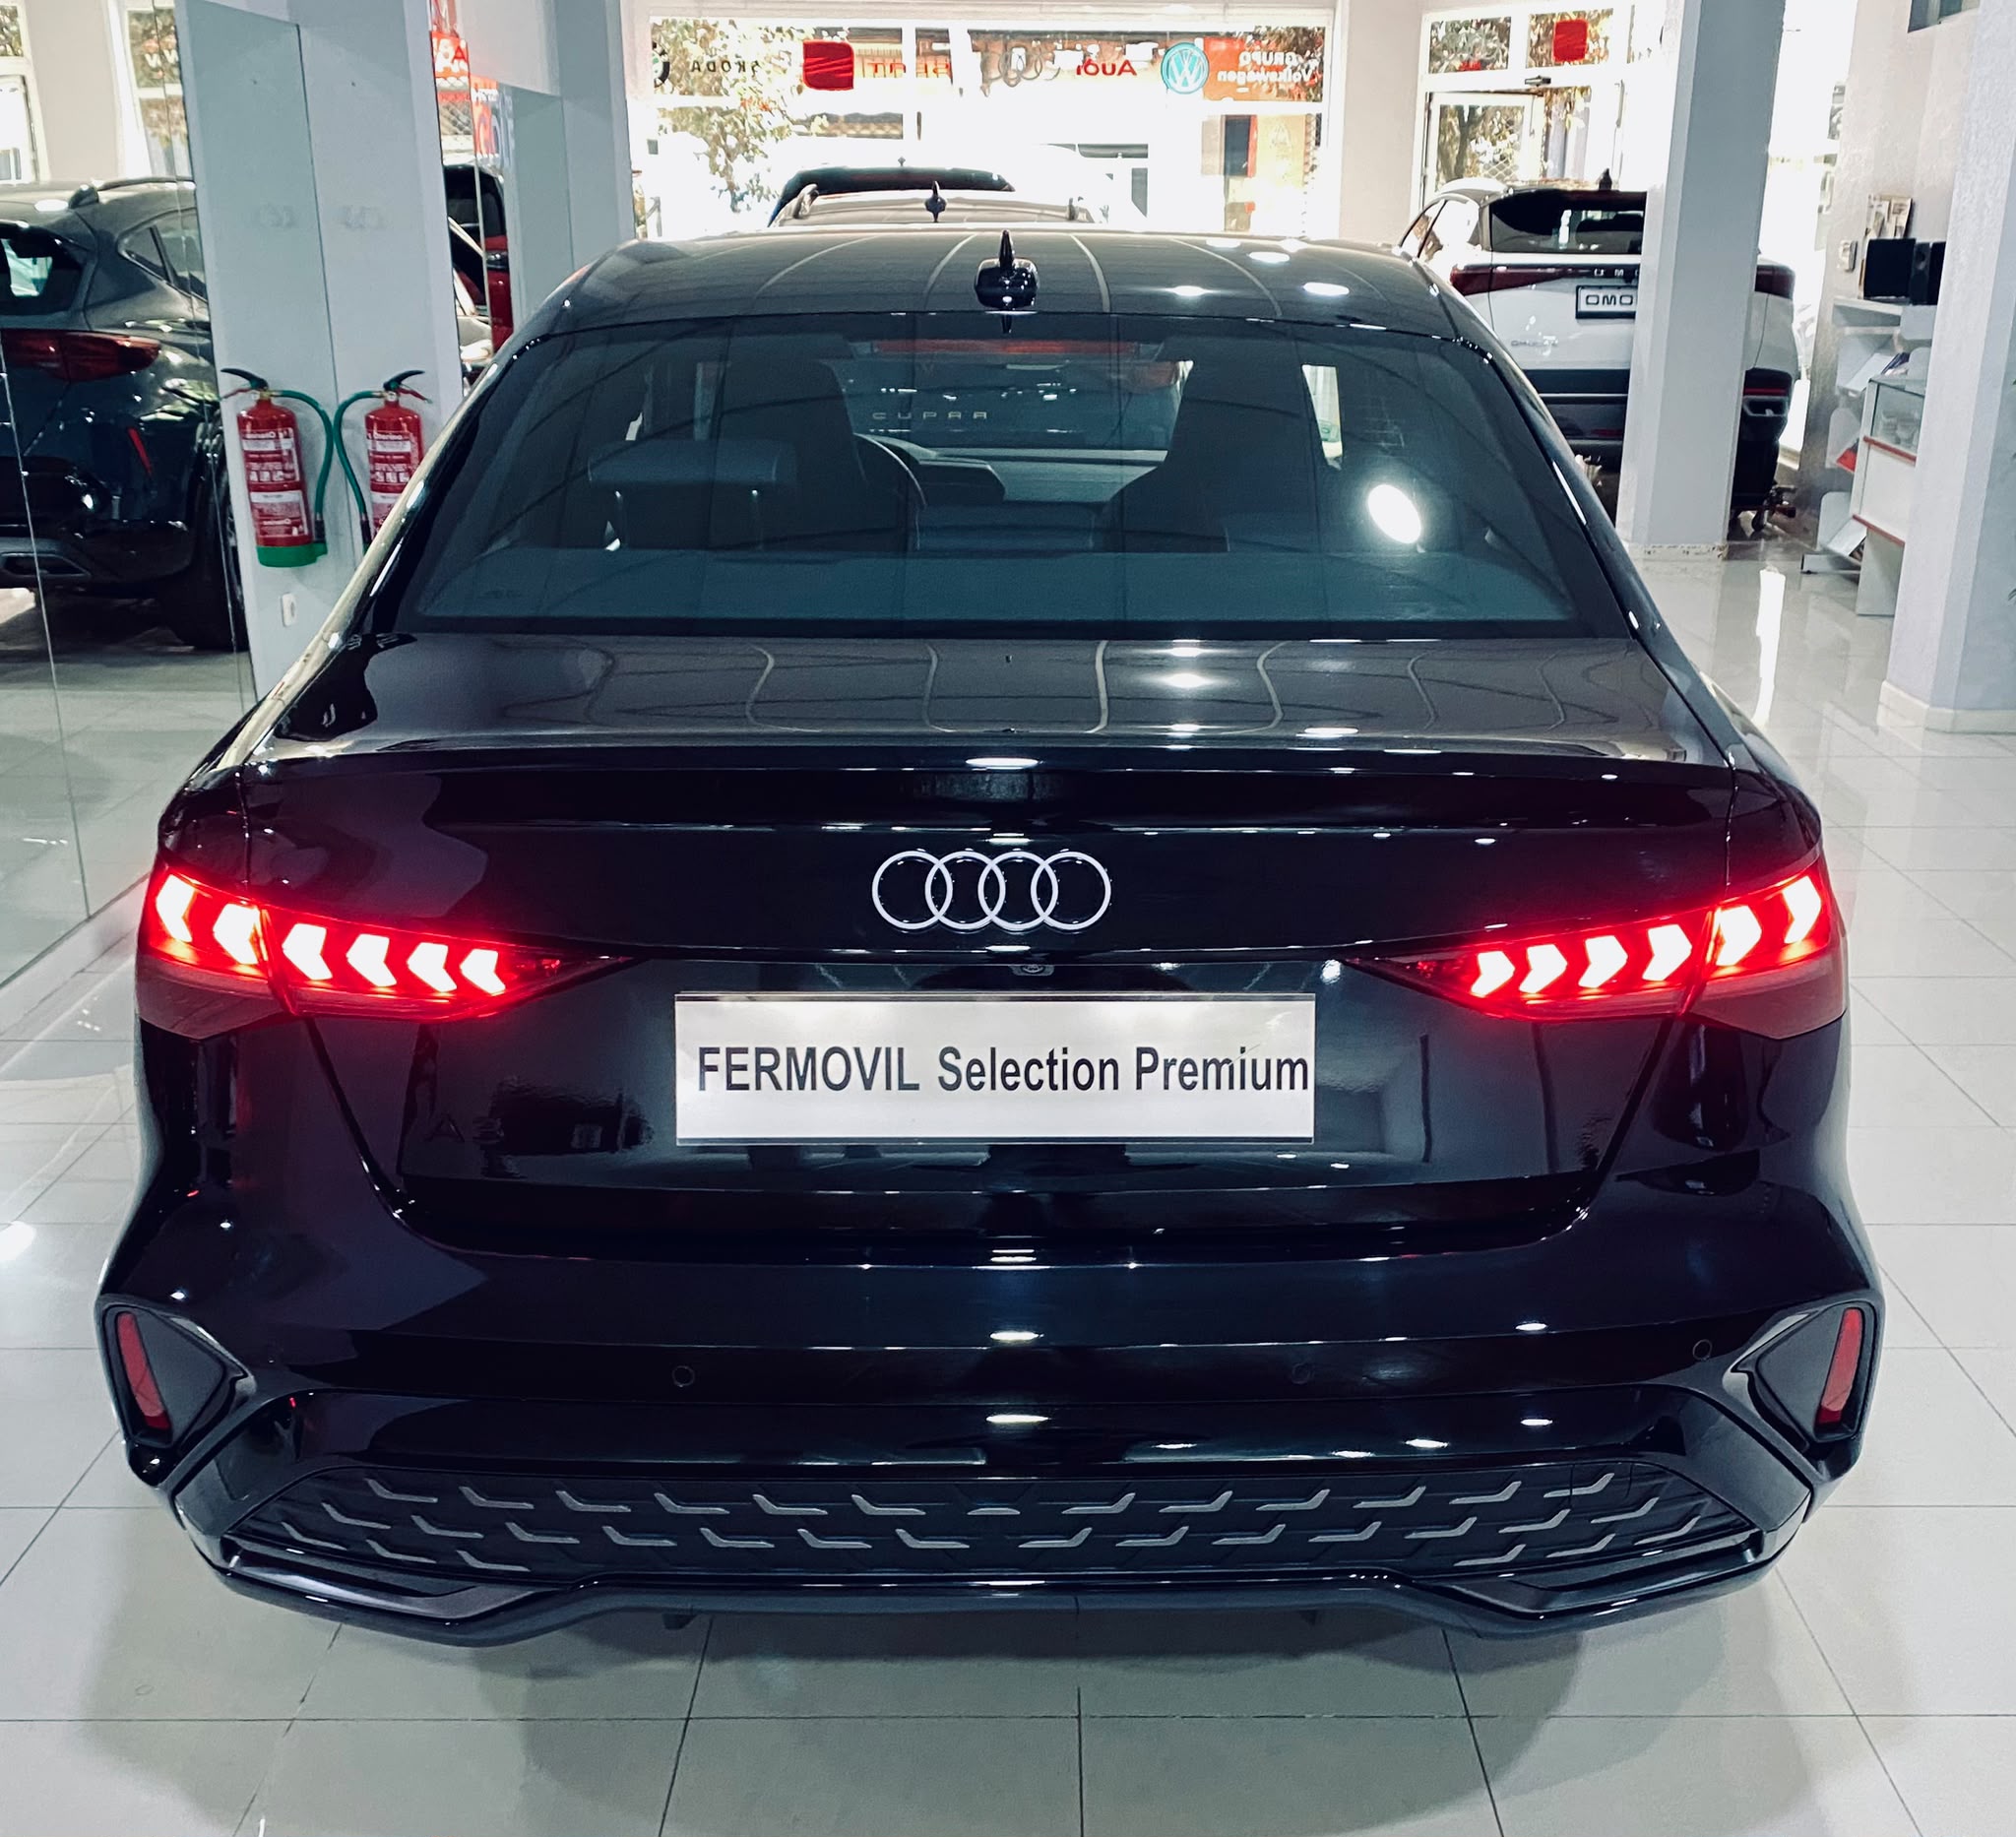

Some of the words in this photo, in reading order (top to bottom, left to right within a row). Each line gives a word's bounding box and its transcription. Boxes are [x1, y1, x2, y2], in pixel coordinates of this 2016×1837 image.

[1585, 294, 1637, 305] OMO
[872, 411, 987, 420] CUPRA
[699, 1045, 920, 1092] FERMOVIL
[938, 1045, 1118, 1092] Selection
[1136, 1045, 1308, 1092] Premium
